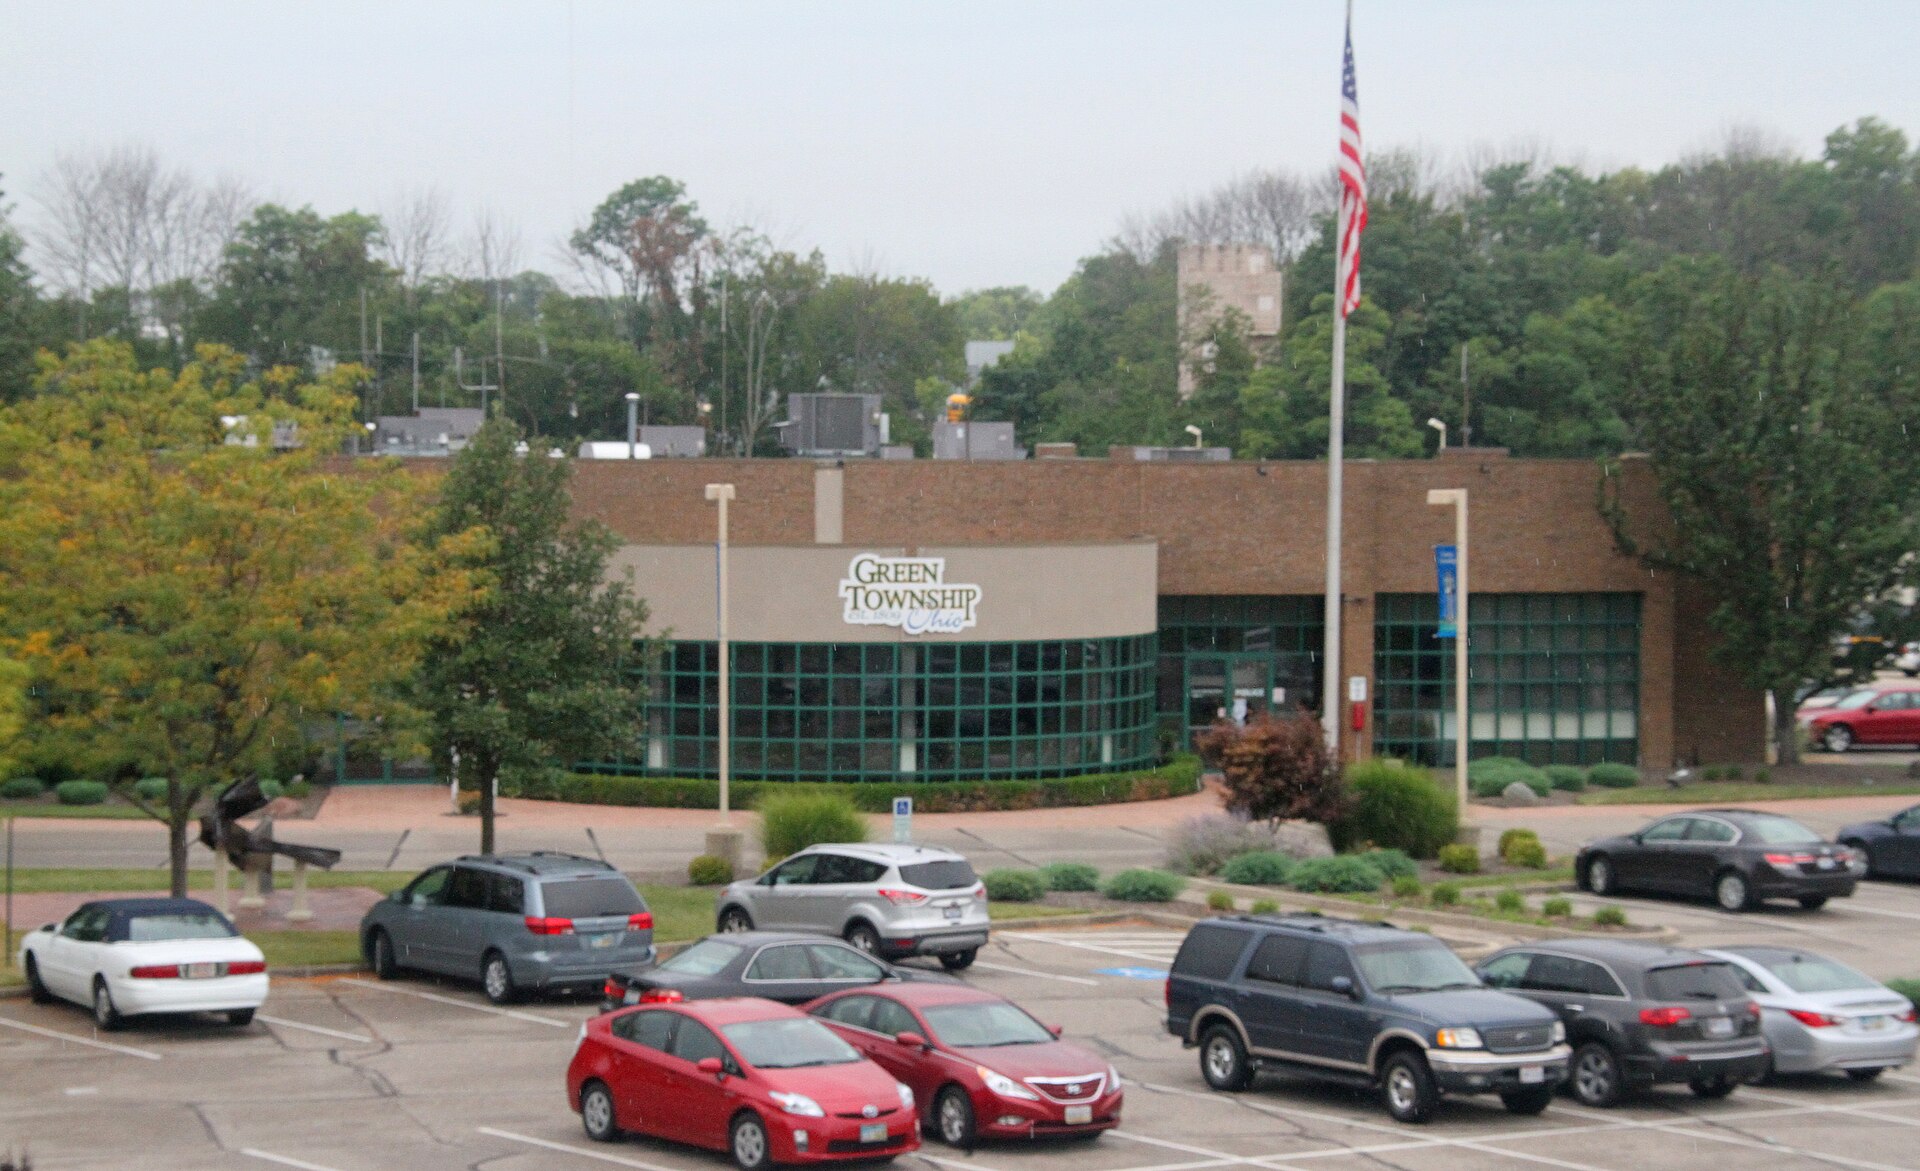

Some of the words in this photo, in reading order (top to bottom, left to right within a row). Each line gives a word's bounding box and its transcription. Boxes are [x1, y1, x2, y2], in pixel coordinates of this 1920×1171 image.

[855, 558, 938, 584] GREEN
[845, 586, 976, 621] TOWNSHIP
[907, 607, 963, 630] Ohio
